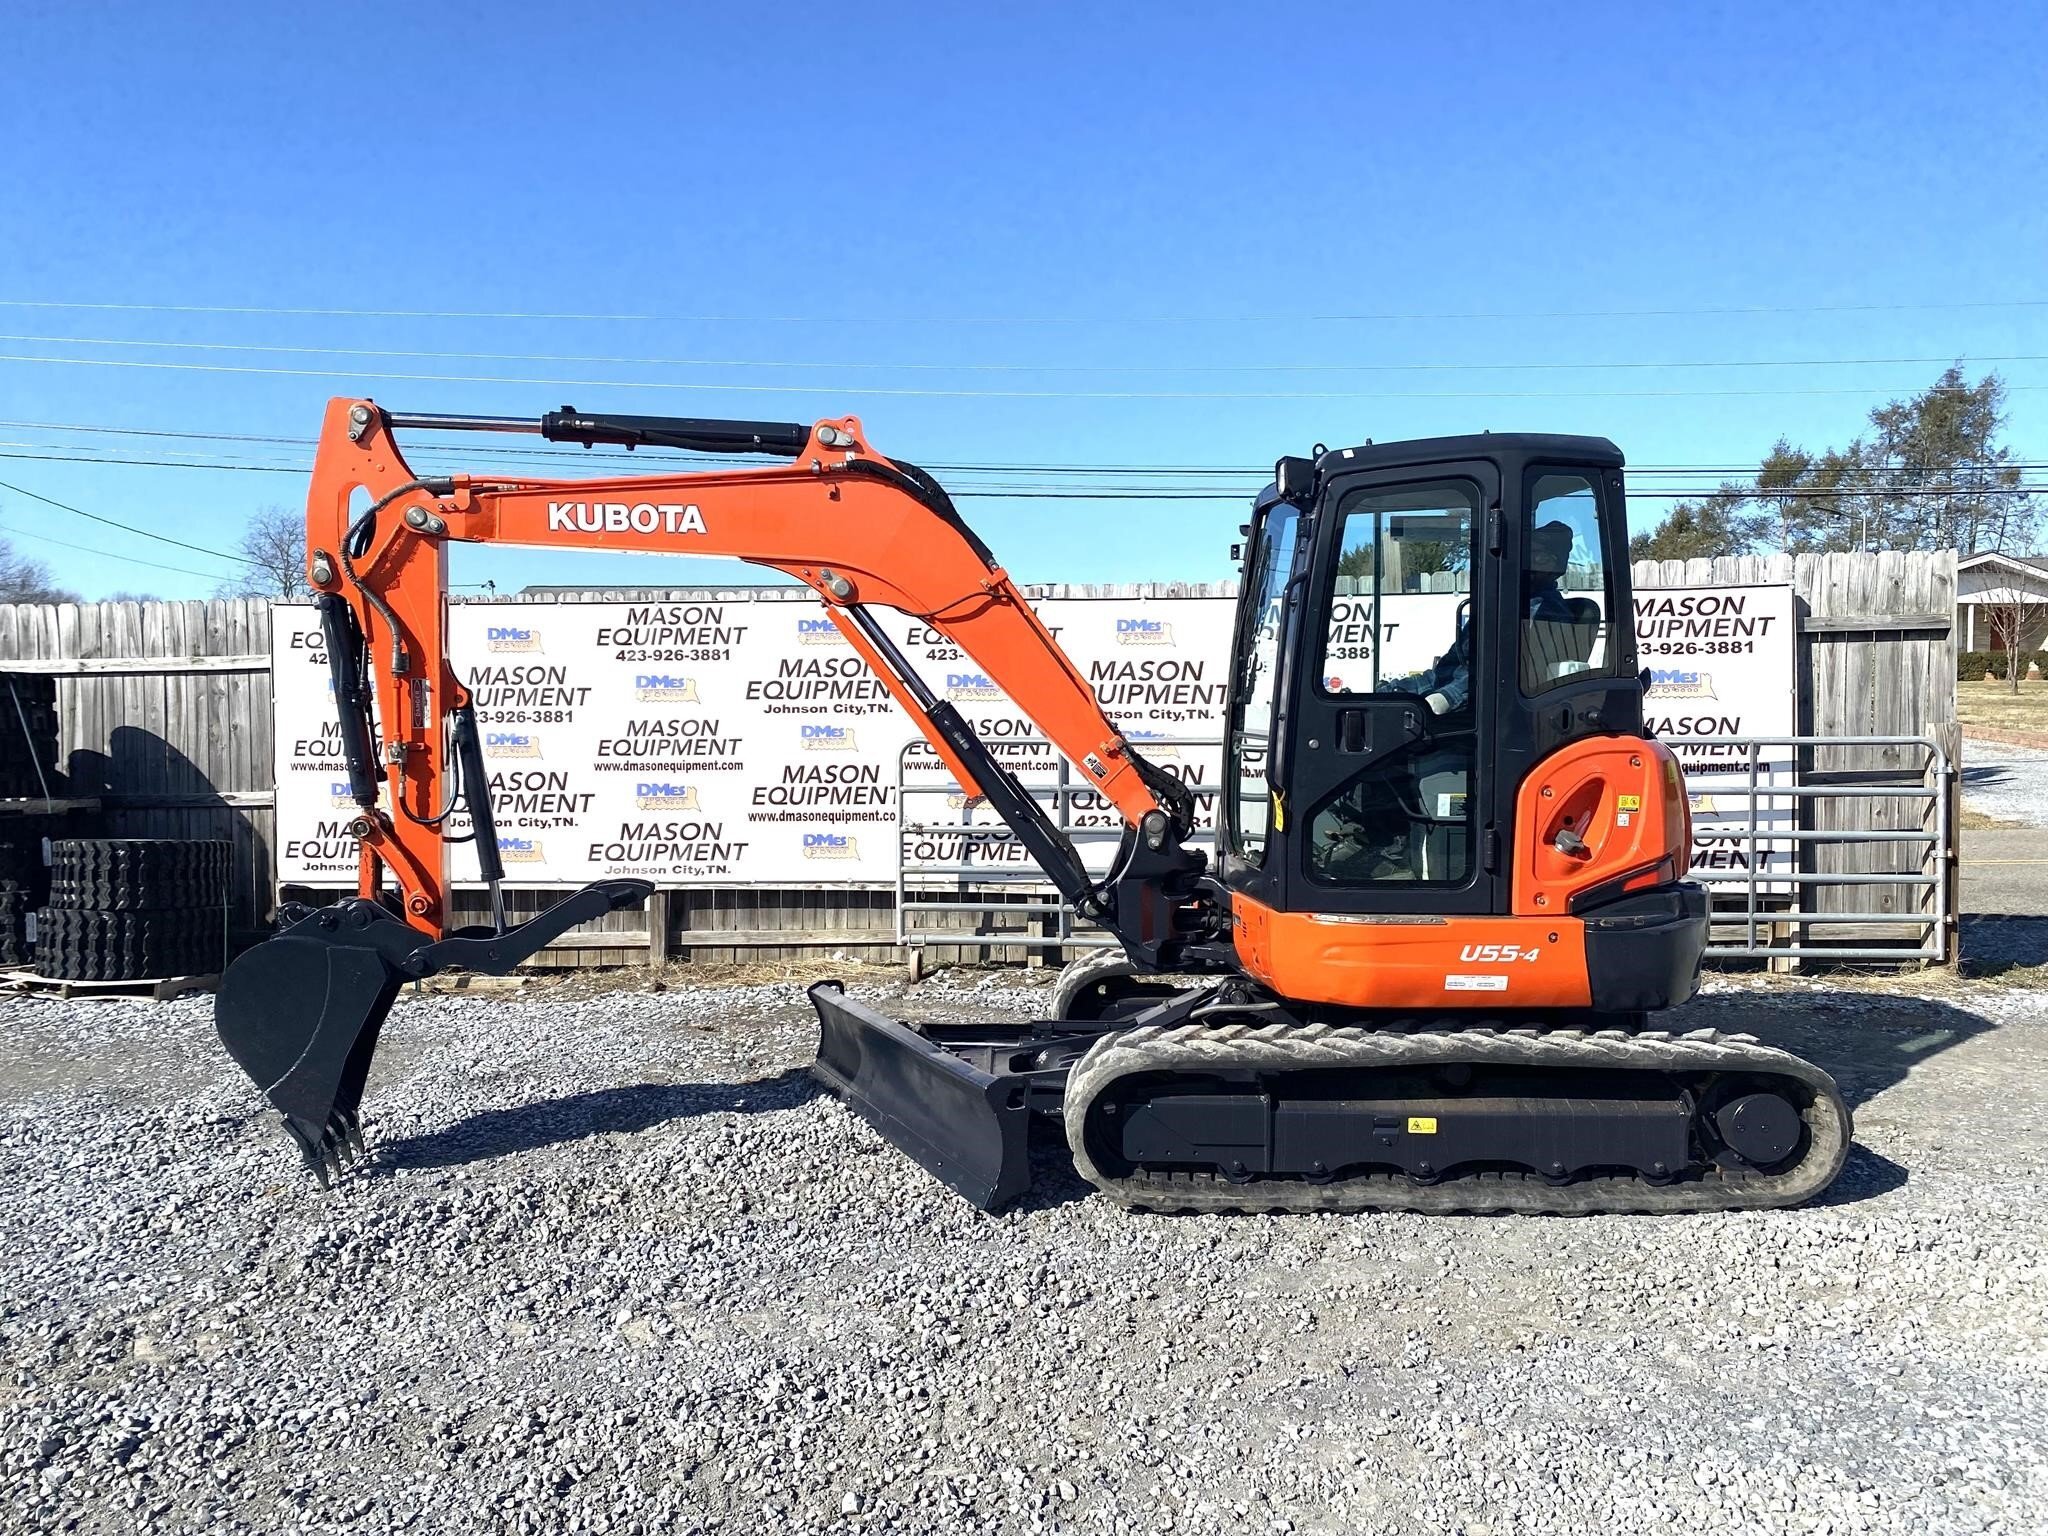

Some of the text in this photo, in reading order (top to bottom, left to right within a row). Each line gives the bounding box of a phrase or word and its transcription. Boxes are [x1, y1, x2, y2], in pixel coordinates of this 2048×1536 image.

[547, 502, 708, 534] KUBOTA
[626, 607, 724, 626] MASON
[596, 627, 748, 646] EQUIPMENT
[615, 649, 730, 661] 423-926-3881
[468, 666, 567, 686] MASON
[1089, 660, 1204, 681] MASON
[474, 687, 592, 707] UIPMENT
[763, 703, 893, 716] Johnson City,TN.
[1148, 709, 1215, 722] City,TN.
[626, 719, 720, 737] MASON
[597, 738, 743, 757] EQUIPMENT
[594, 760, 744, 773] www.dmasonequipment.com
[782, 764, 881, 784] MASON
[487, 771, 569, 792] ASON
[518, 816, 579, 830] City,TN.
[747, 809, 896, 825] www.dmasonequipment.co
[619, 822, 723, 841] MASON
[587, 842, 749, 861] EQUIPMENT
[604, 864, 731, 876] Johnson City,TN.
[1459, 944, 1540, 962] U55-4
